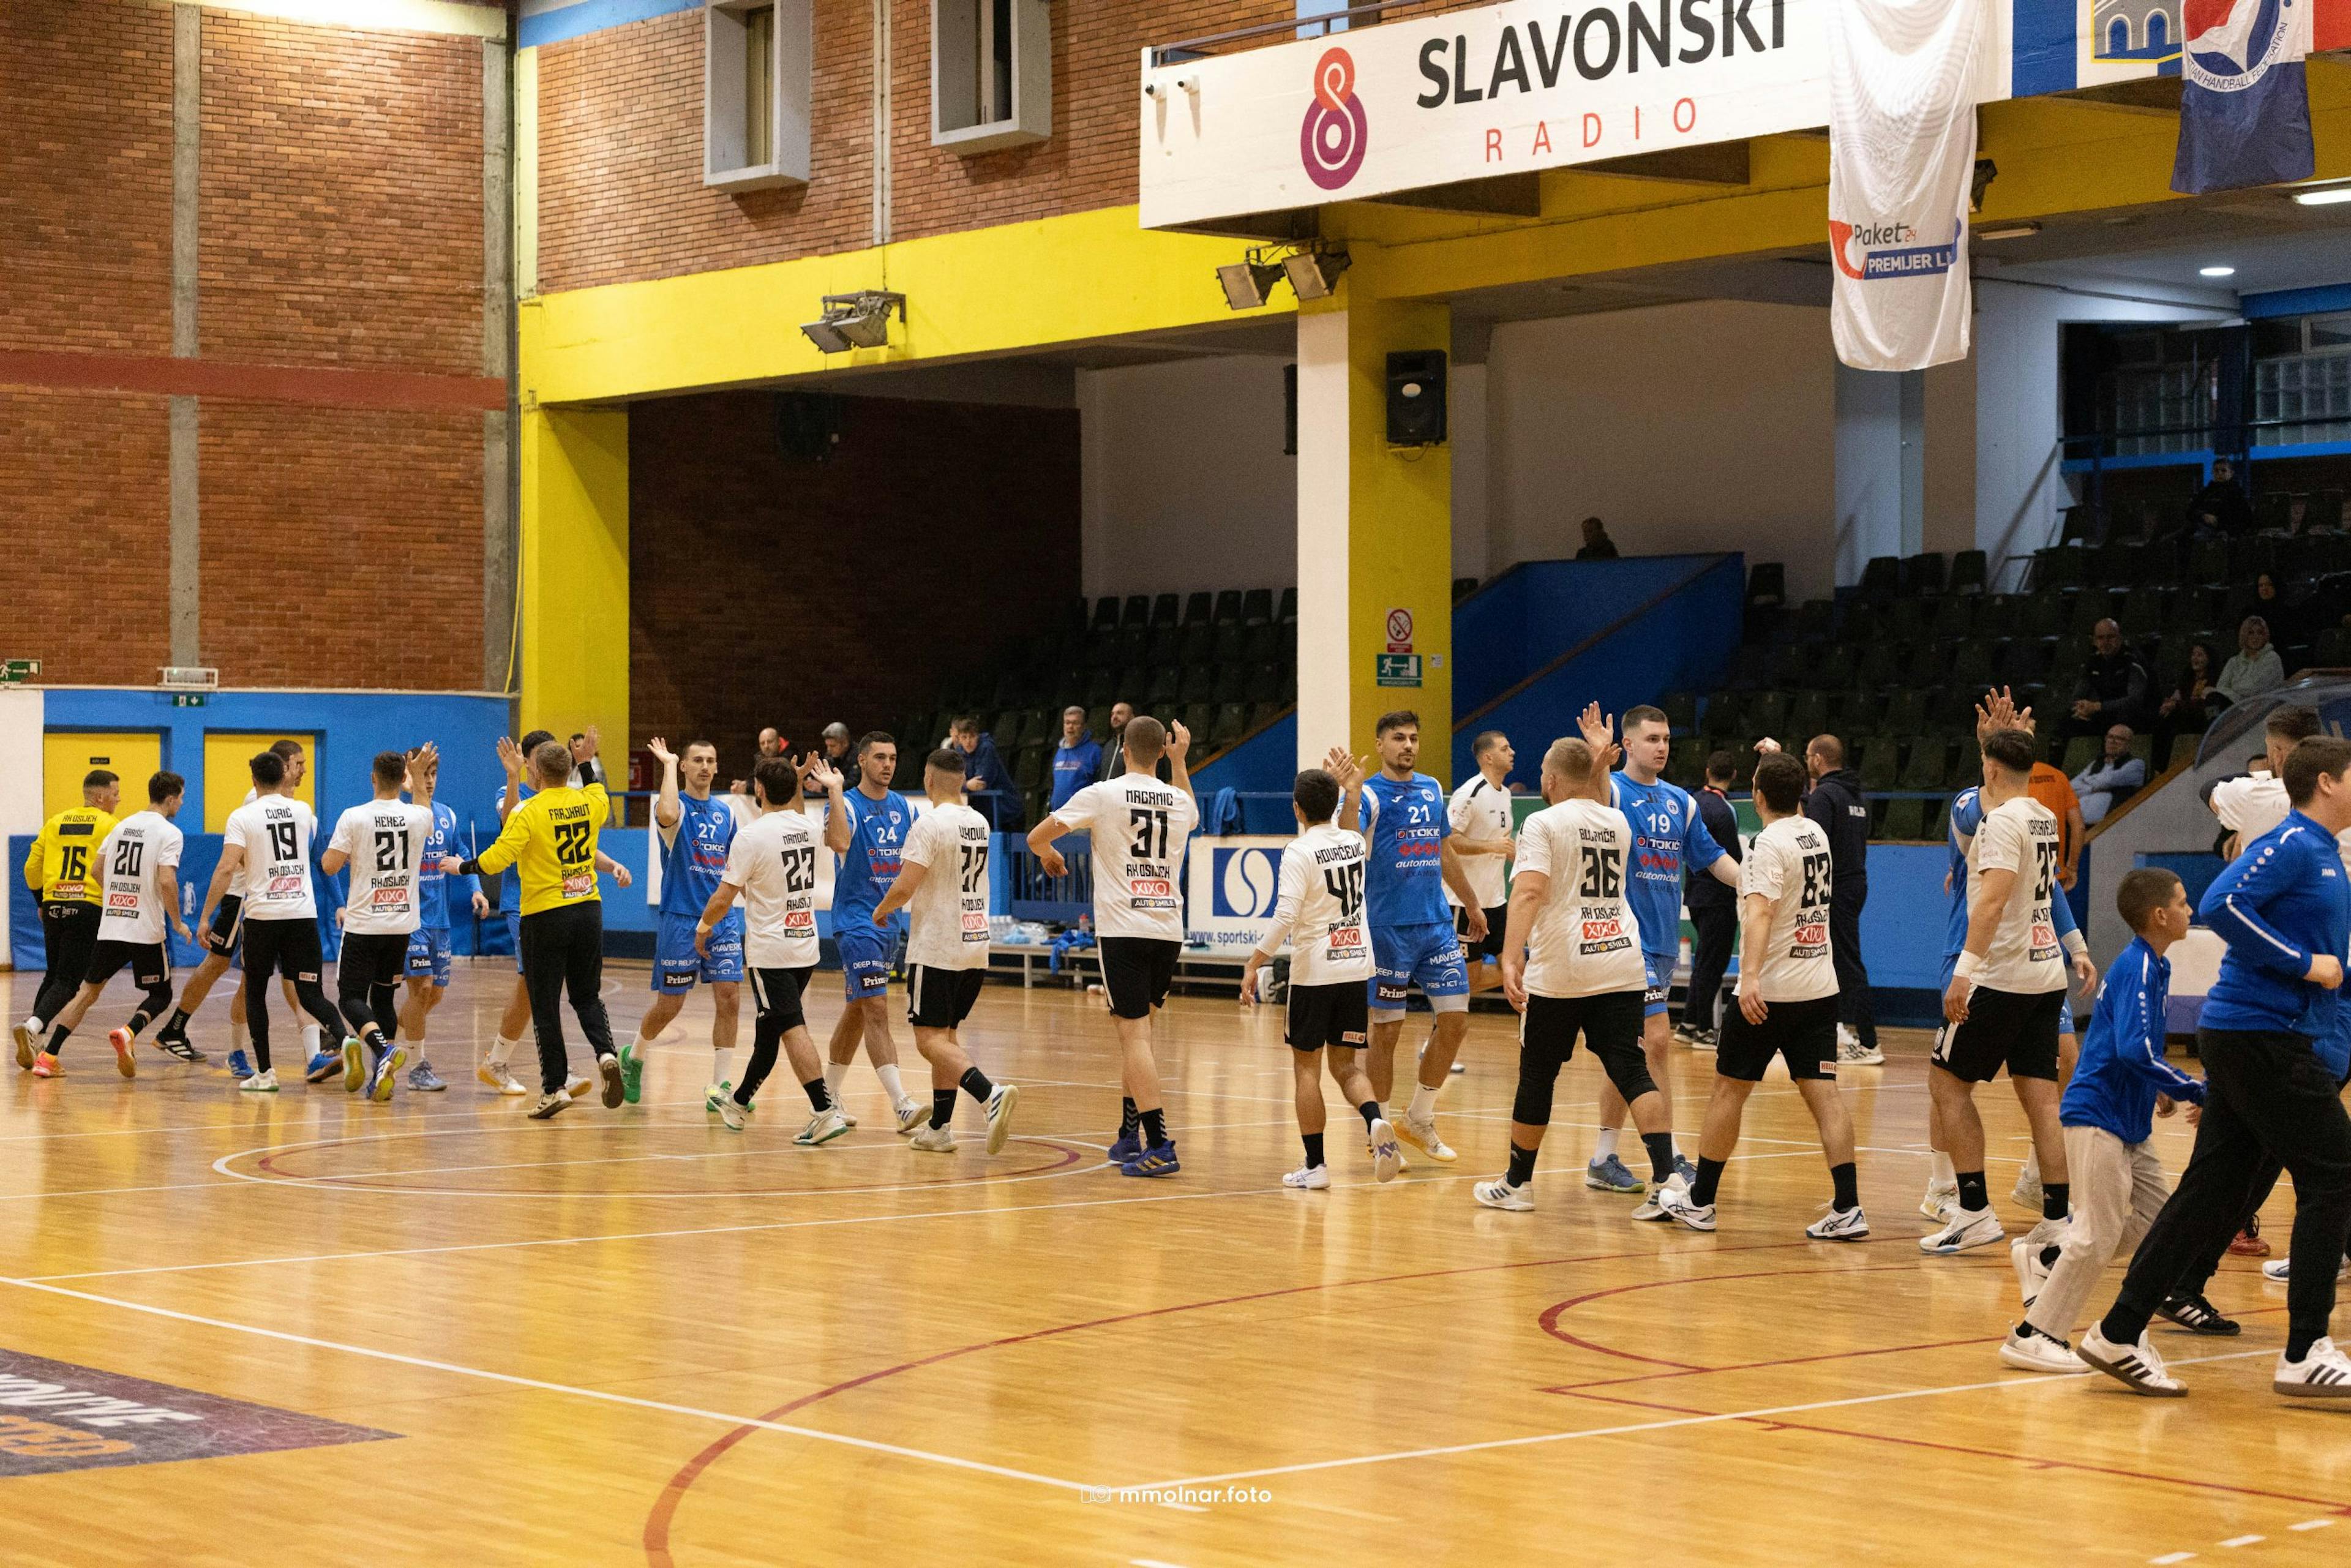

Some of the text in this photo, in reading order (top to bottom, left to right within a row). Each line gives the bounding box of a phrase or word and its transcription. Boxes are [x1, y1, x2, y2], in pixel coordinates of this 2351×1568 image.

[1417, 0, 1785, 109] SLAVONSKI
[2204, 76, 2251, 90] HANDBALL
[2252, 22, 2288, 81] FEDERATION
[1486, 97, 1696, 162] RADIO
[1854, 222, 1910, 246] Paket
[1869, 253, 1933, 273] PREMIJER
[1408, 804, 1431, 823] 21
[1647, 813, 1670, 833] 19
[699, 823, 716, 839] 27
[877, 826, 898, 843] 24
[1130, 809, 1168, 859] 31
[266, 822, 298, 861] 19
[375, 830, 408, 871] 21
[554, 820, 593, 865] 22
[1649, 839, 1680, 850] TOKIĆ
[114, 839, 144, 877] 20
[879, 848, 901, 857] TOKI
[59, 846, 87, 880] 16
[781, 847, 815, 893] 23
[1580, 847, 1621, 898] 36
[377, 890, 405, 902] XIXO
[1134, 883, 1167, 896] XIXO
[1324, 861, 1363, 917] 40
[111, 895, 137, 907] XIXO
[1588, 920, 1619, 937] XIXO
[853, 960, 871, 969] DEEP
[666, 975, 693, 984] Prima
[1379, 987, 1407, 999] Prim
[1821, 1062, 1834, 1071] HELL
